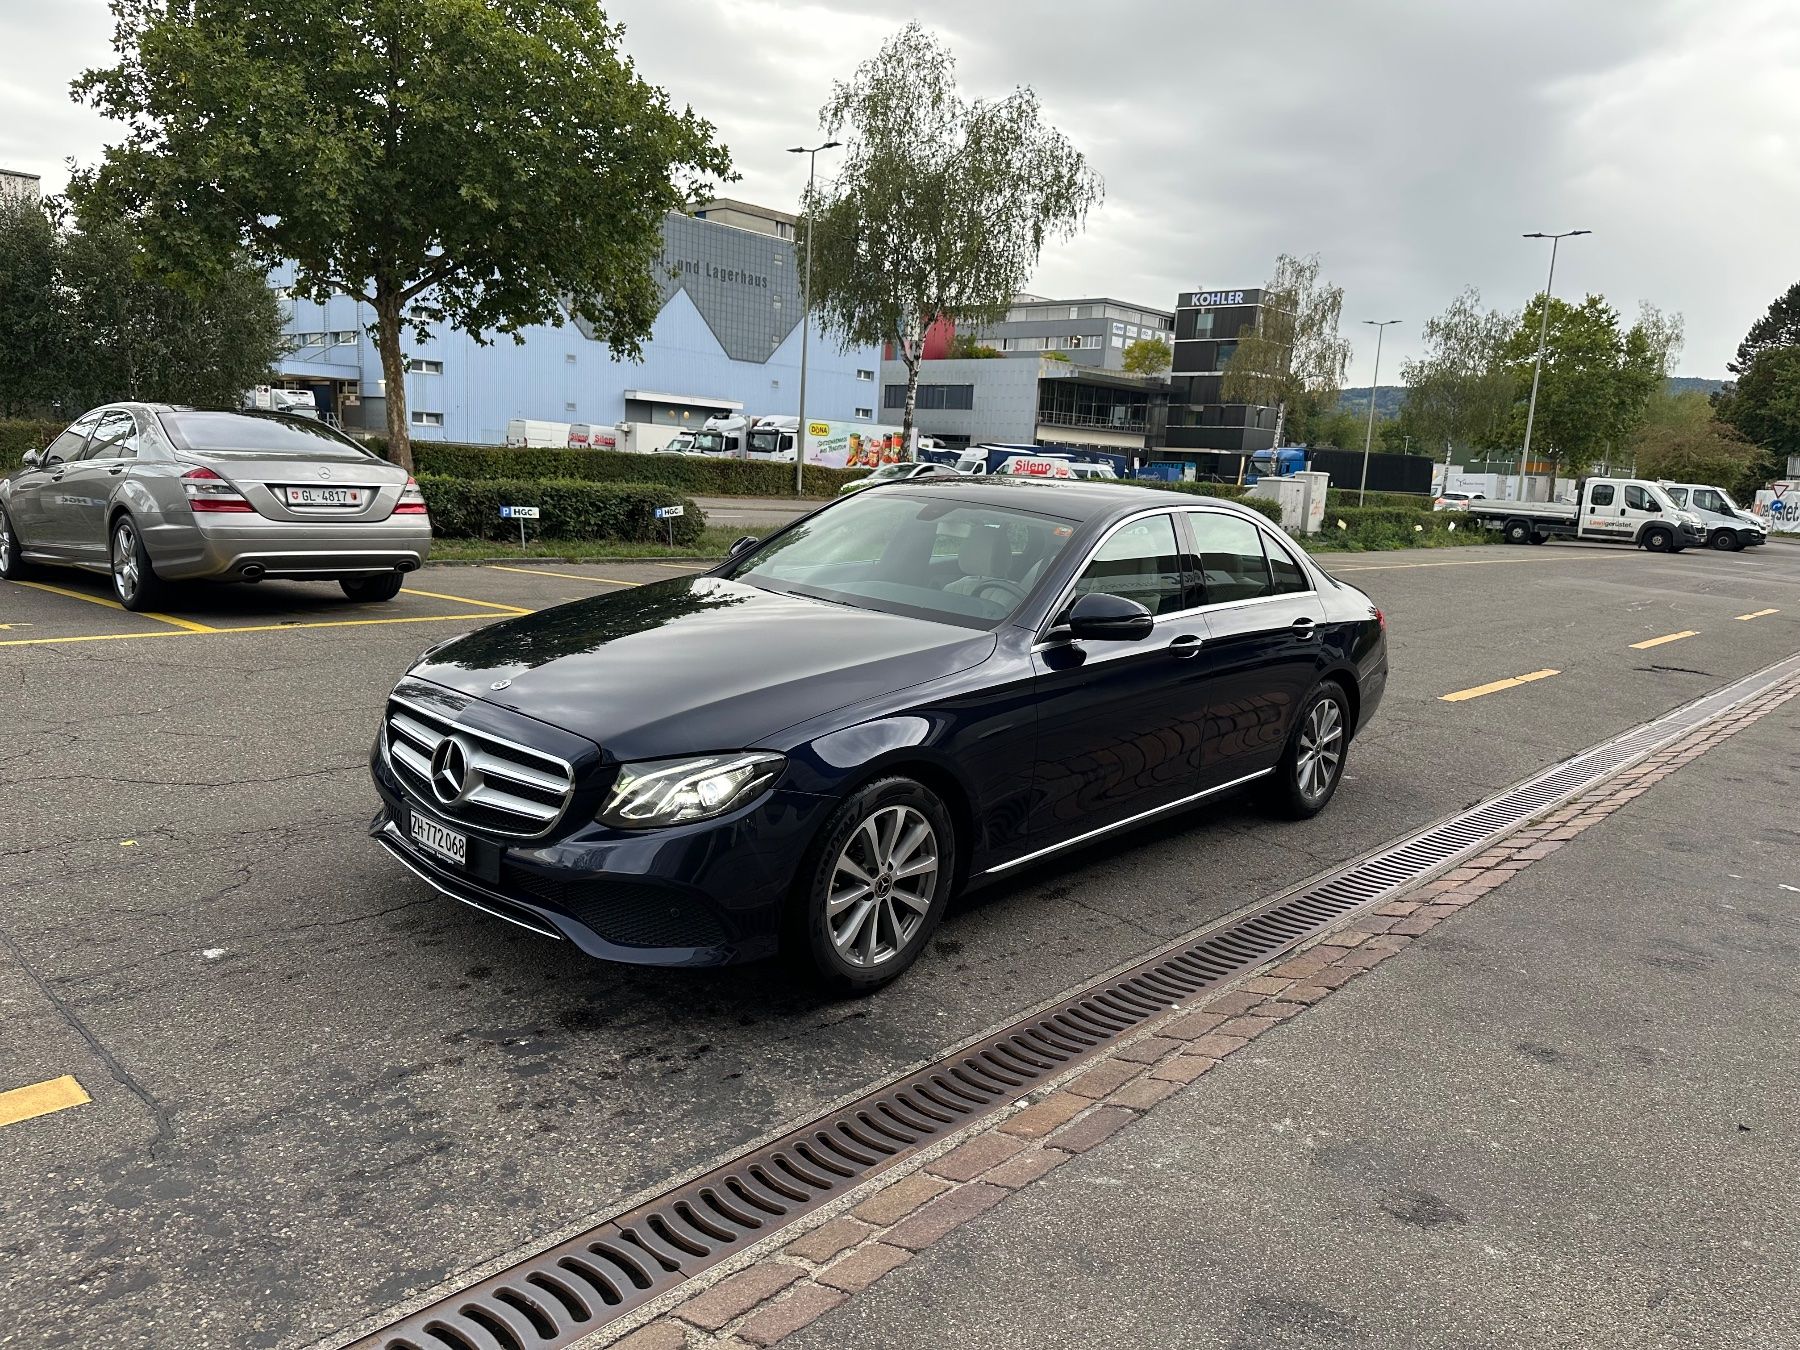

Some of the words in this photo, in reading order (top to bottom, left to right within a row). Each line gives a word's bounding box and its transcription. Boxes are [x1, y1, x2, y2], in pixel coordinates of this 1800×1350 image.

[678, 260, 699, 274] und
[706, 262, 768, 288] Lagerhaus
[1191, 291, 1244, 306] KOHLER
[1015, 460, 1051, 472] Sileno
[513, 508, 532, 516] HGC
